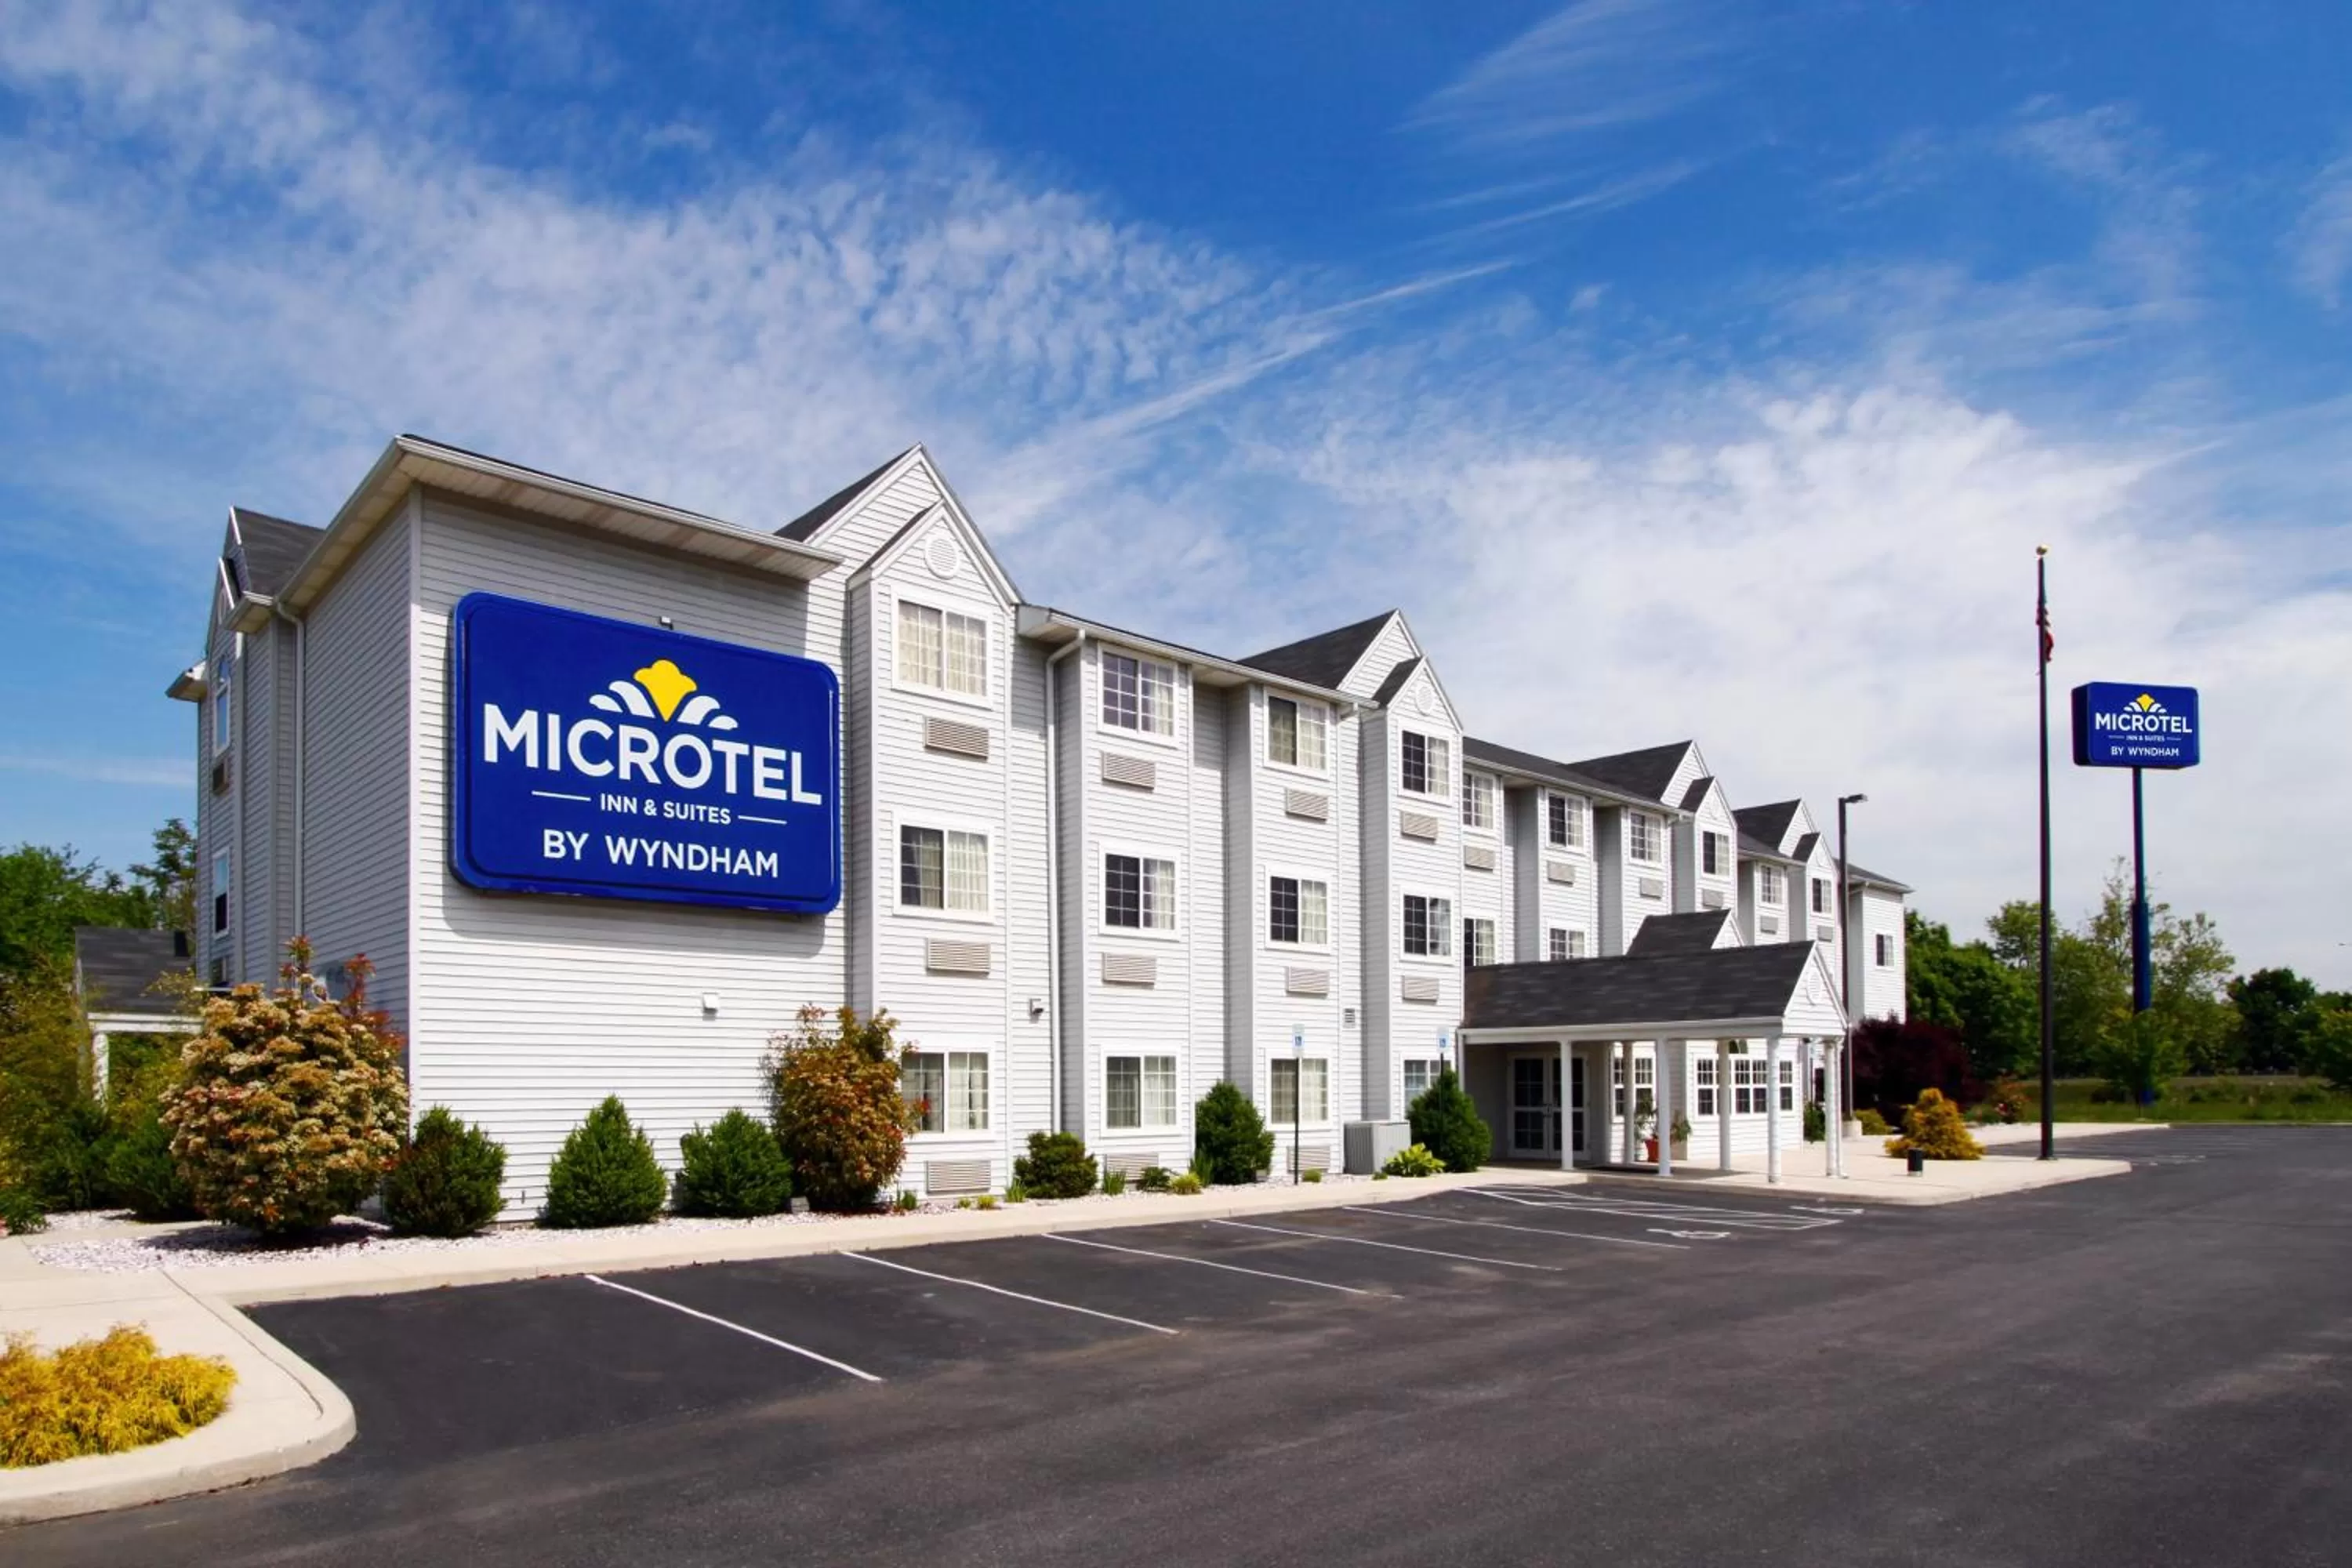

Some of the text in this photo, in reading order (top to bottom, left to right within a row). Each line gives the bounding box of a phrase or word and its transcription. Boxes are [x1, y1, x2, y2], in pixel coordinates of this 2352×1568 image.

[2095, 712, 2193, 733] MICROTEL
[484, 703, 822, 805] MICROTEL
[2111, 746, 2180, 757] BY WYNDHAM
[601, 793, 731, 825] INN & SUITES
[543, 829, 779, 878] BY WYNDHAM
